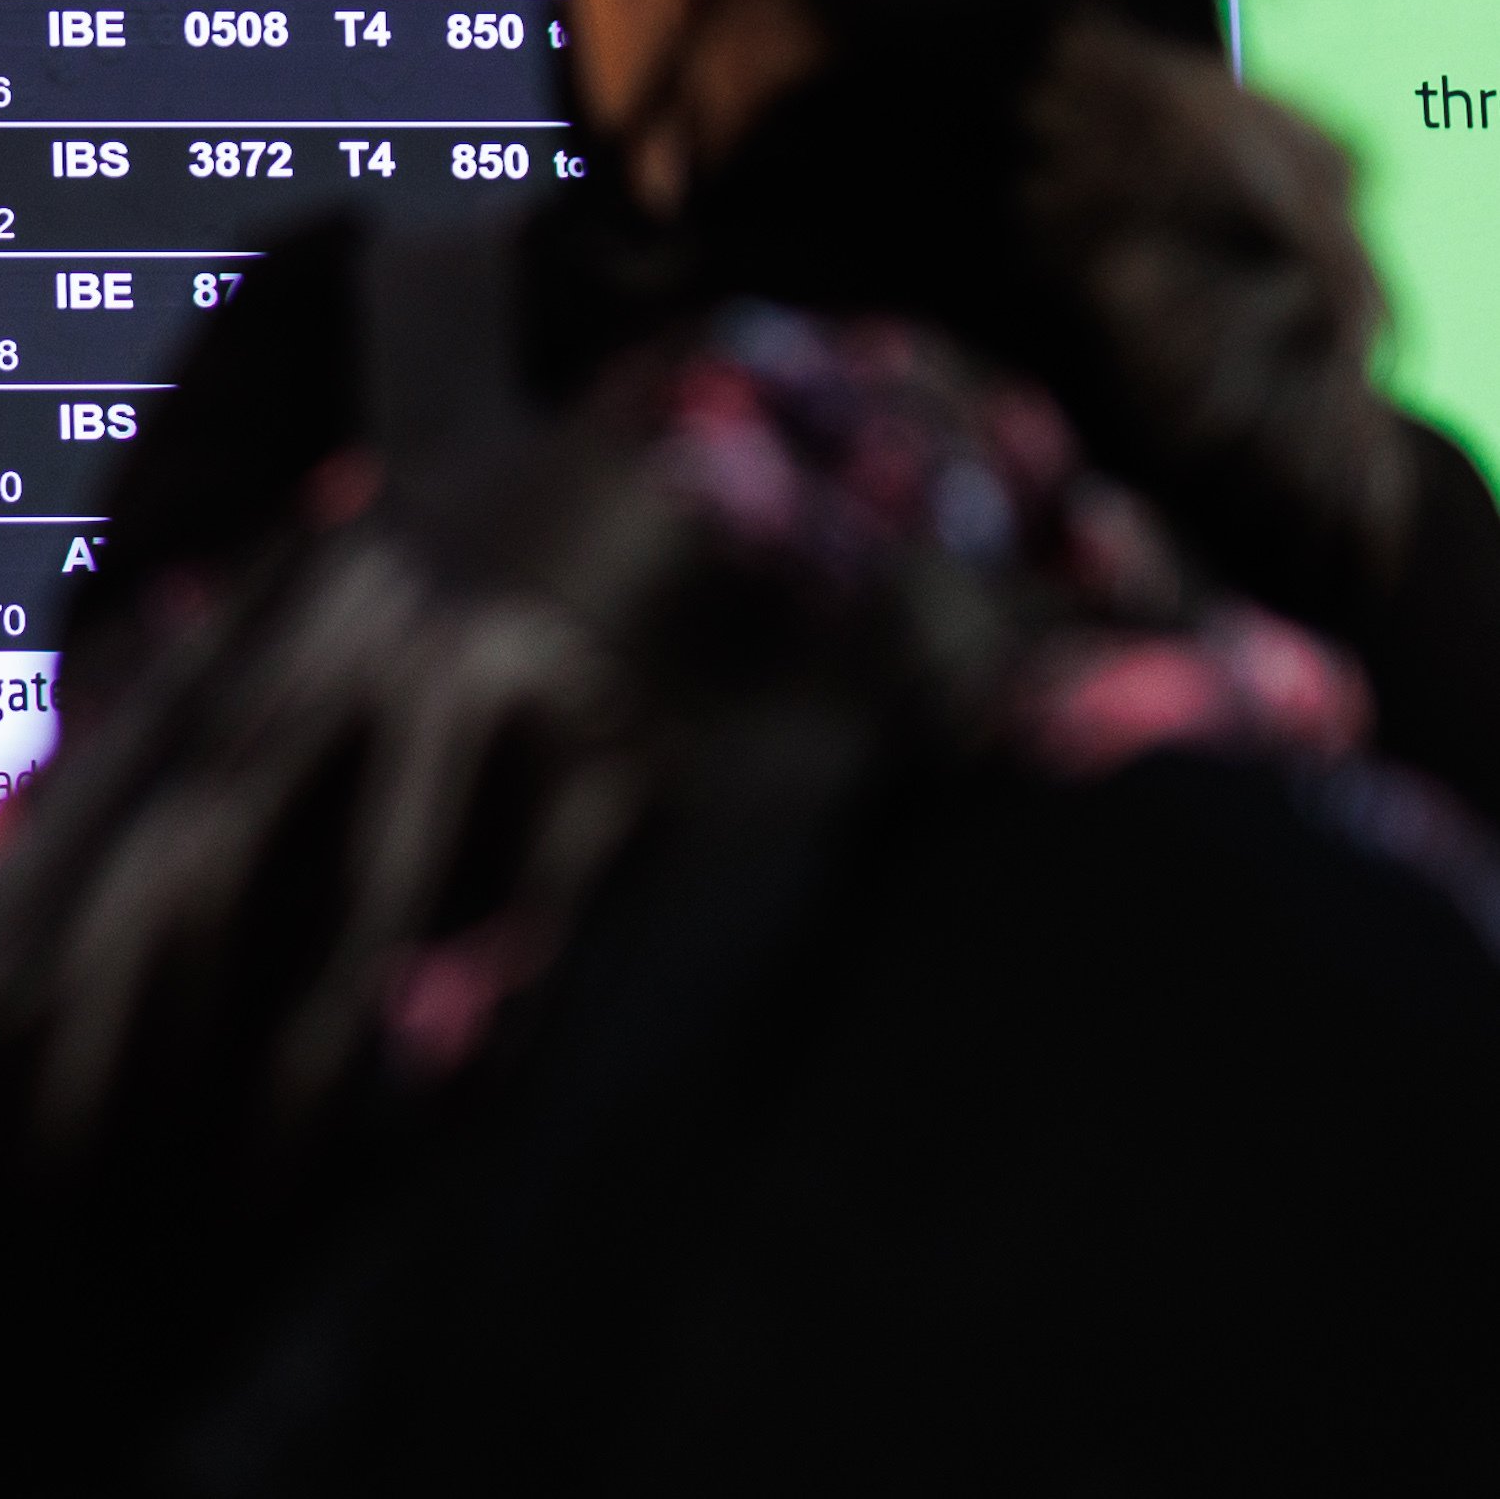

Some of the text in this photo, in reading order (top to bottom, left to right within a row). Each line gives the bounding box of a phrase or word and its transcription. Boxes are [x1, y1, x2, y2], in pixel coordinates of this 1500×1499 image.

[48, 11, 126, 47] IBE
[184, 11, 289, 47] 0508
[334, 11, 392, 47] T4
[446, 13, 525, 50] 850
[1414, 74, 1500, 131] thr
[52, 141, 130, 178] IBS
[188, 141, 294, 178] 3872
[338, 141, 396, 178] T4
[451, 143, 529, 180] 850
[56, 272, 134, 309] IBE
[192, 272, 242, 310] 87
[59, 403, 137, 441] IBS
